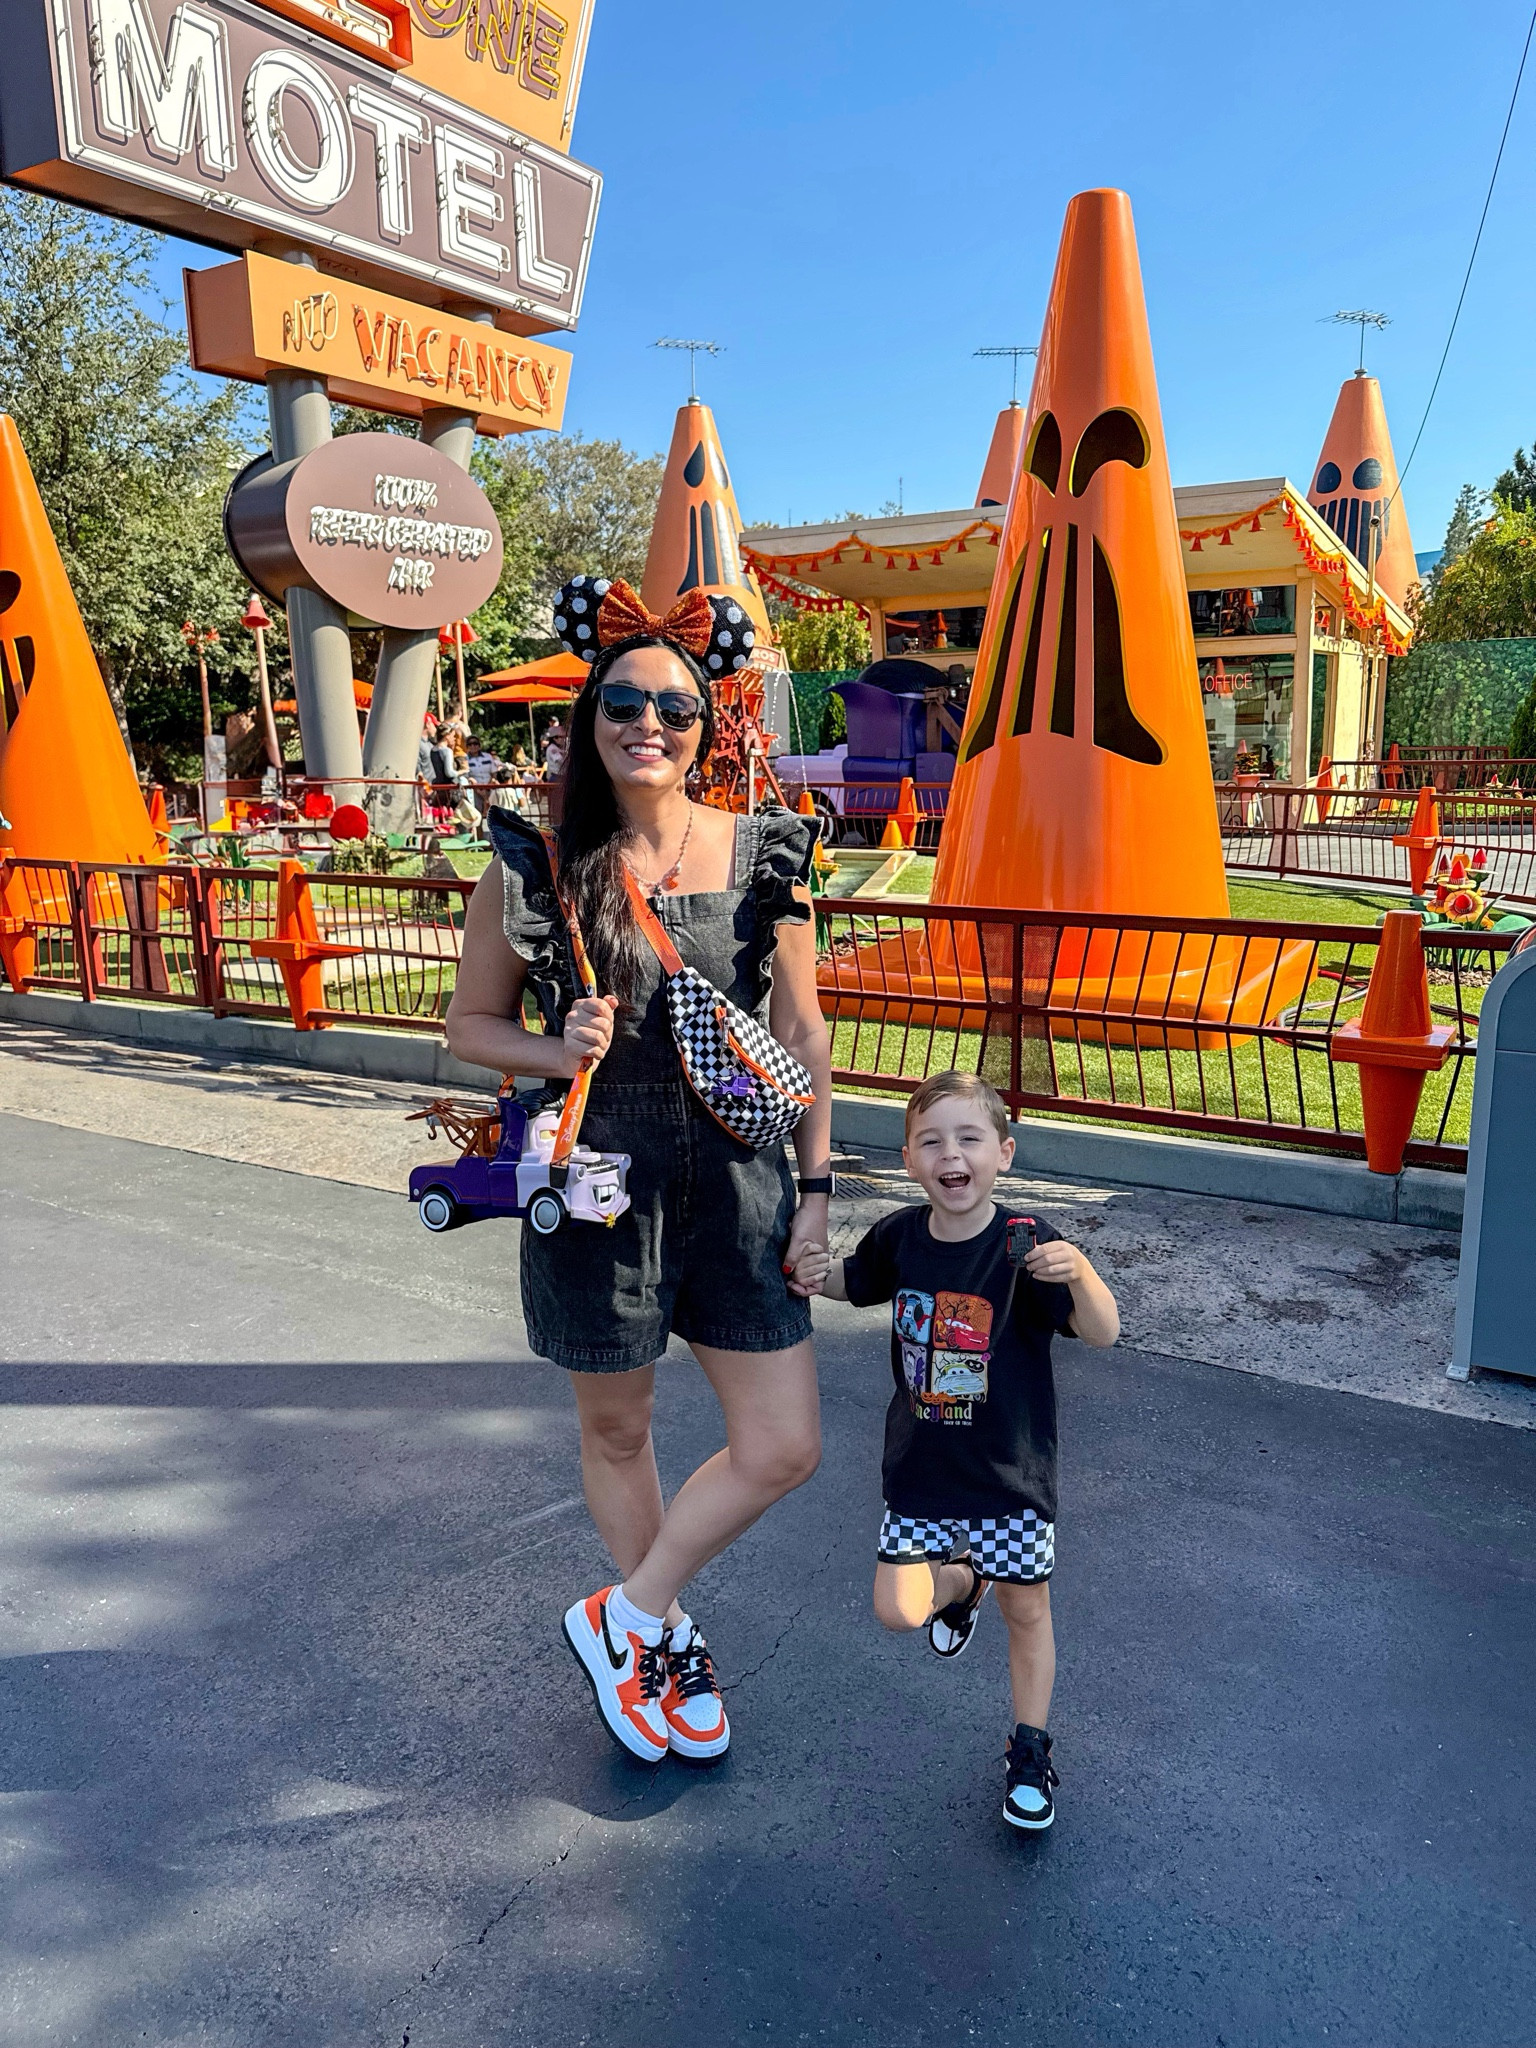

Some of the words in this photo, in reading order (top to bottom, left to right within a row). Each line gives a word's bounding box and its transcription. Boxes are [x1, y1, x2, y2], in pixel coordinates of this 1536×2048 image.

[84, 0, 572, 294] MOTEL
[284, 291, 339, 352] NO
[352, 304, 560, 414] VACANCY
[1204, 673, 1253, 692] OFFICE
